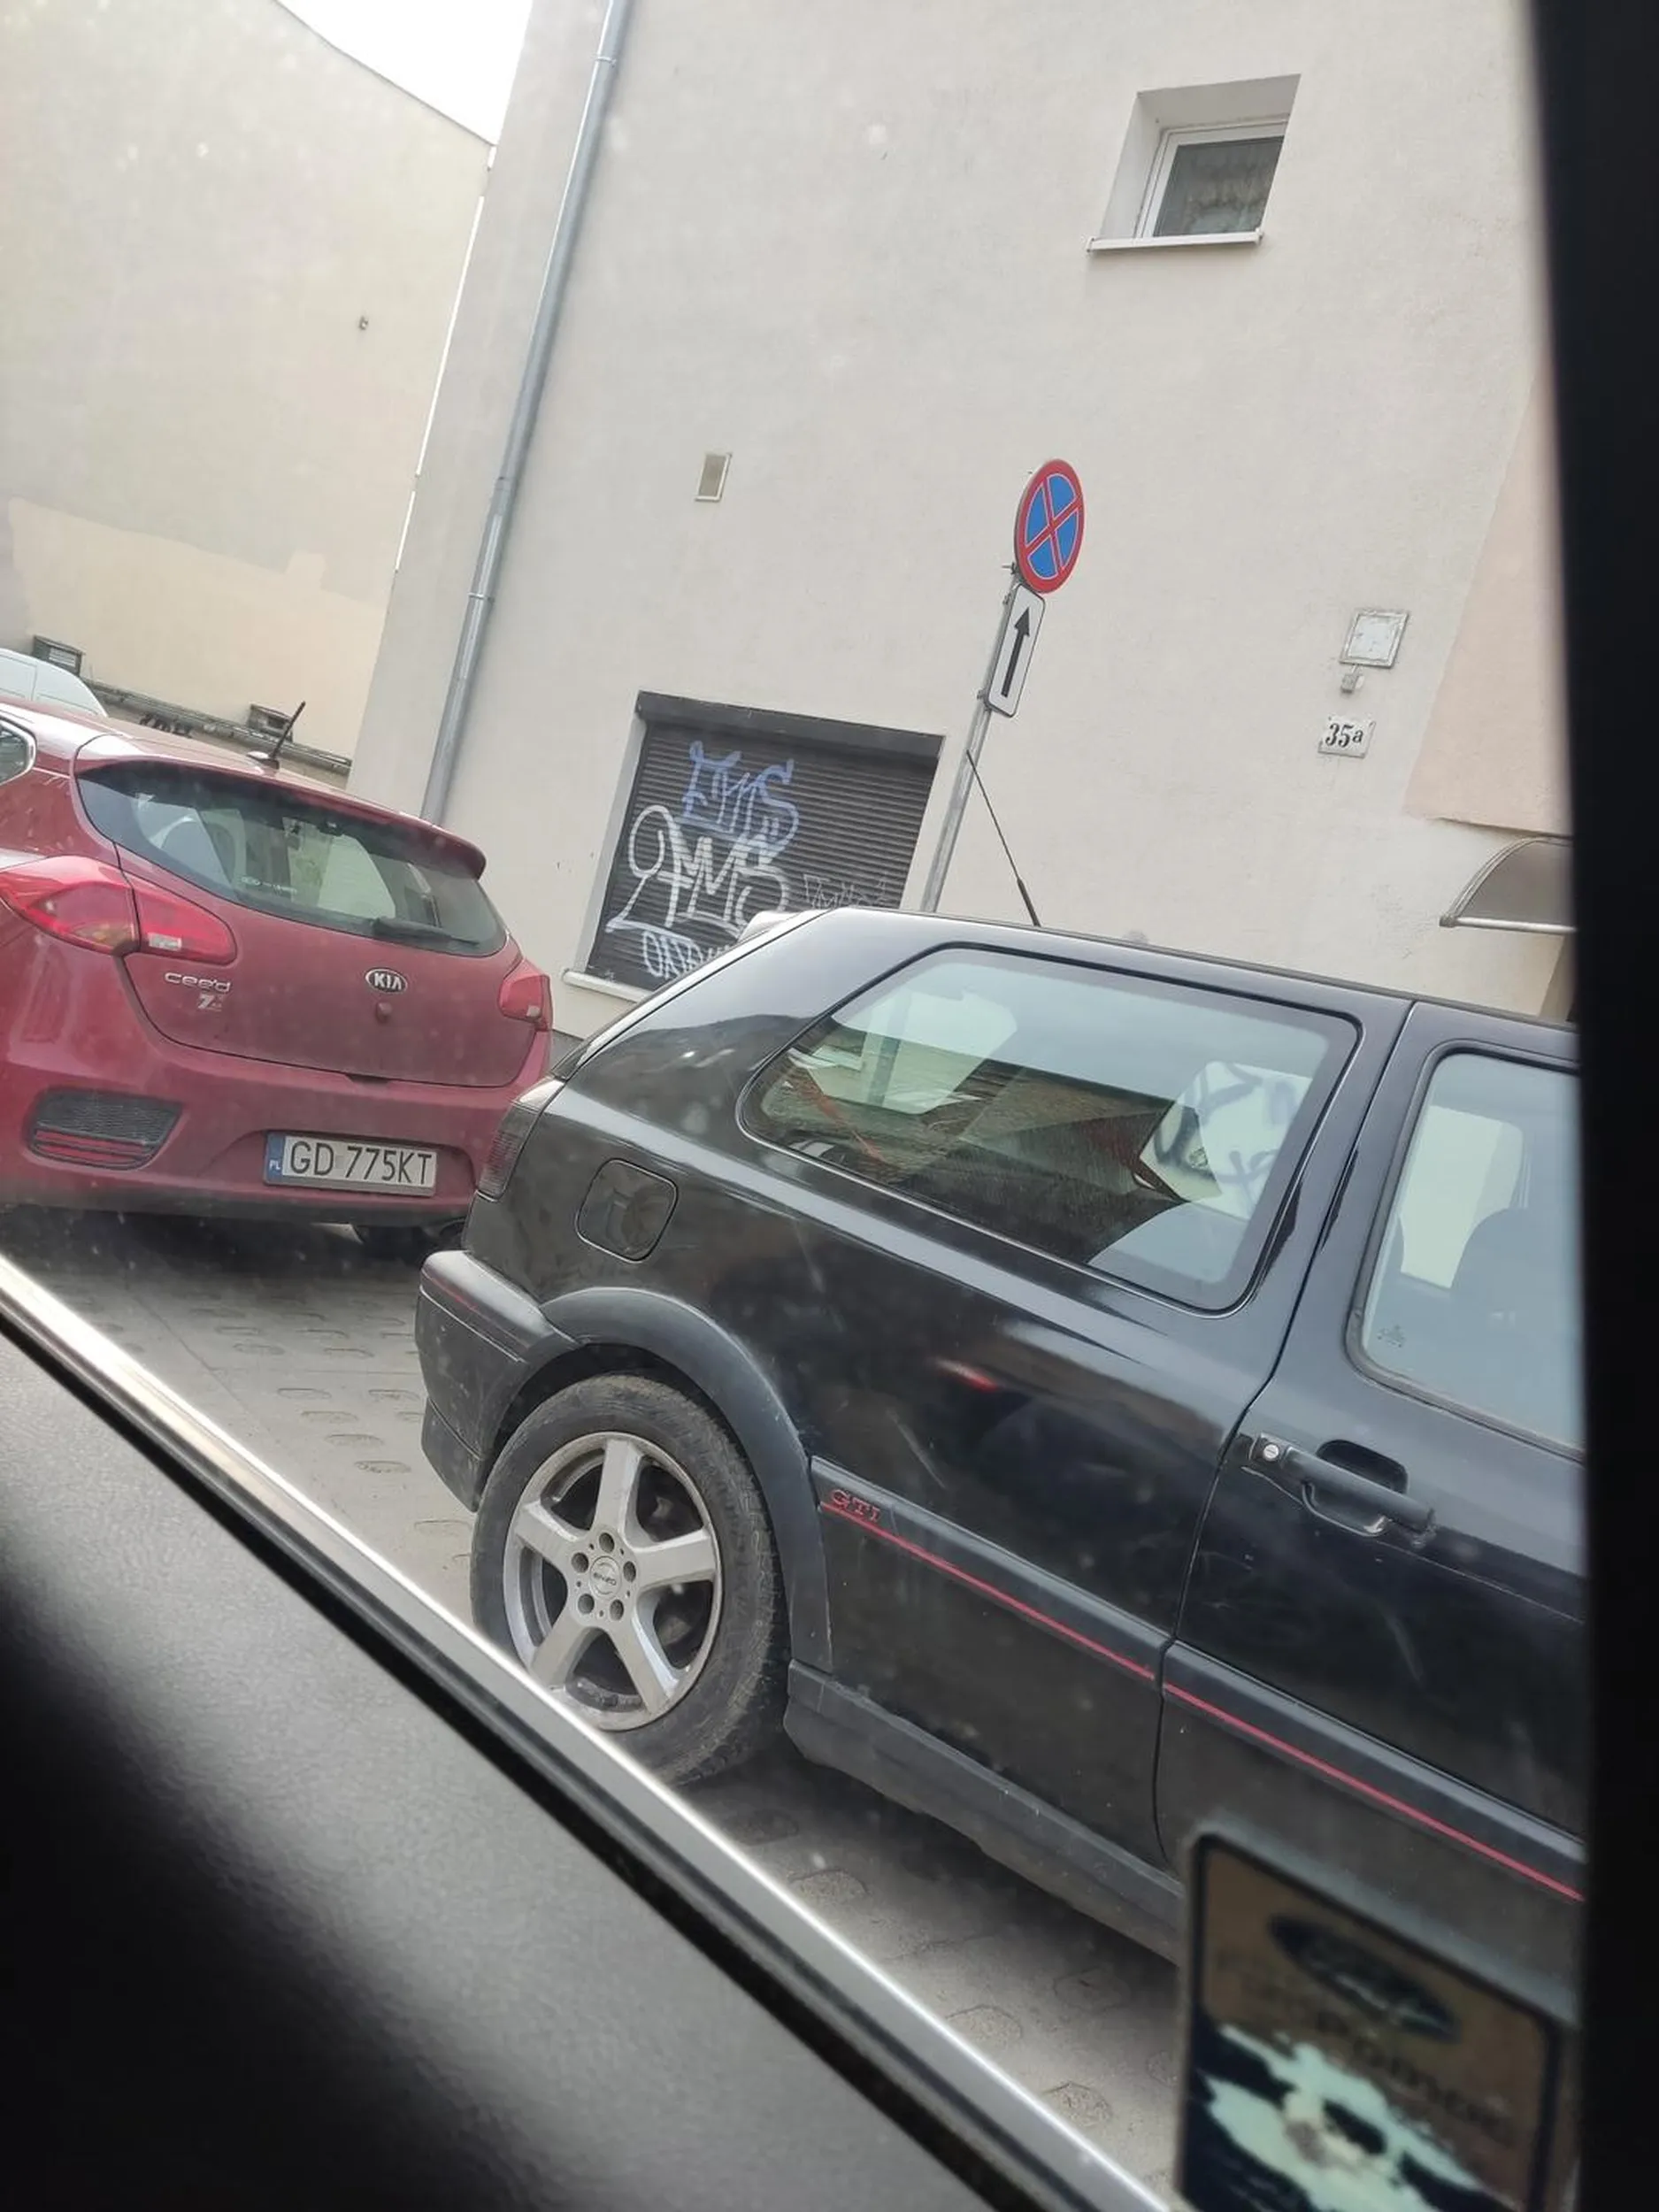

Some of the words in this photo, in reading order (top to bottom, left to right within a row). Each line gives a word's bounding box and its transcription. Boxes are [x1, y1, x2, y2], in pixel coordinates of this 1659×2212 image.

[1325, 723, 1363, 748] 35a
[373, 972, 403, 991] KIA
[269, 1159, 281, 1171] PL
[290, 1141, 334, 1176] GD
[345, 1145, 433, 1185] 775KT
[831, 1488, 881, 1522] GTI
